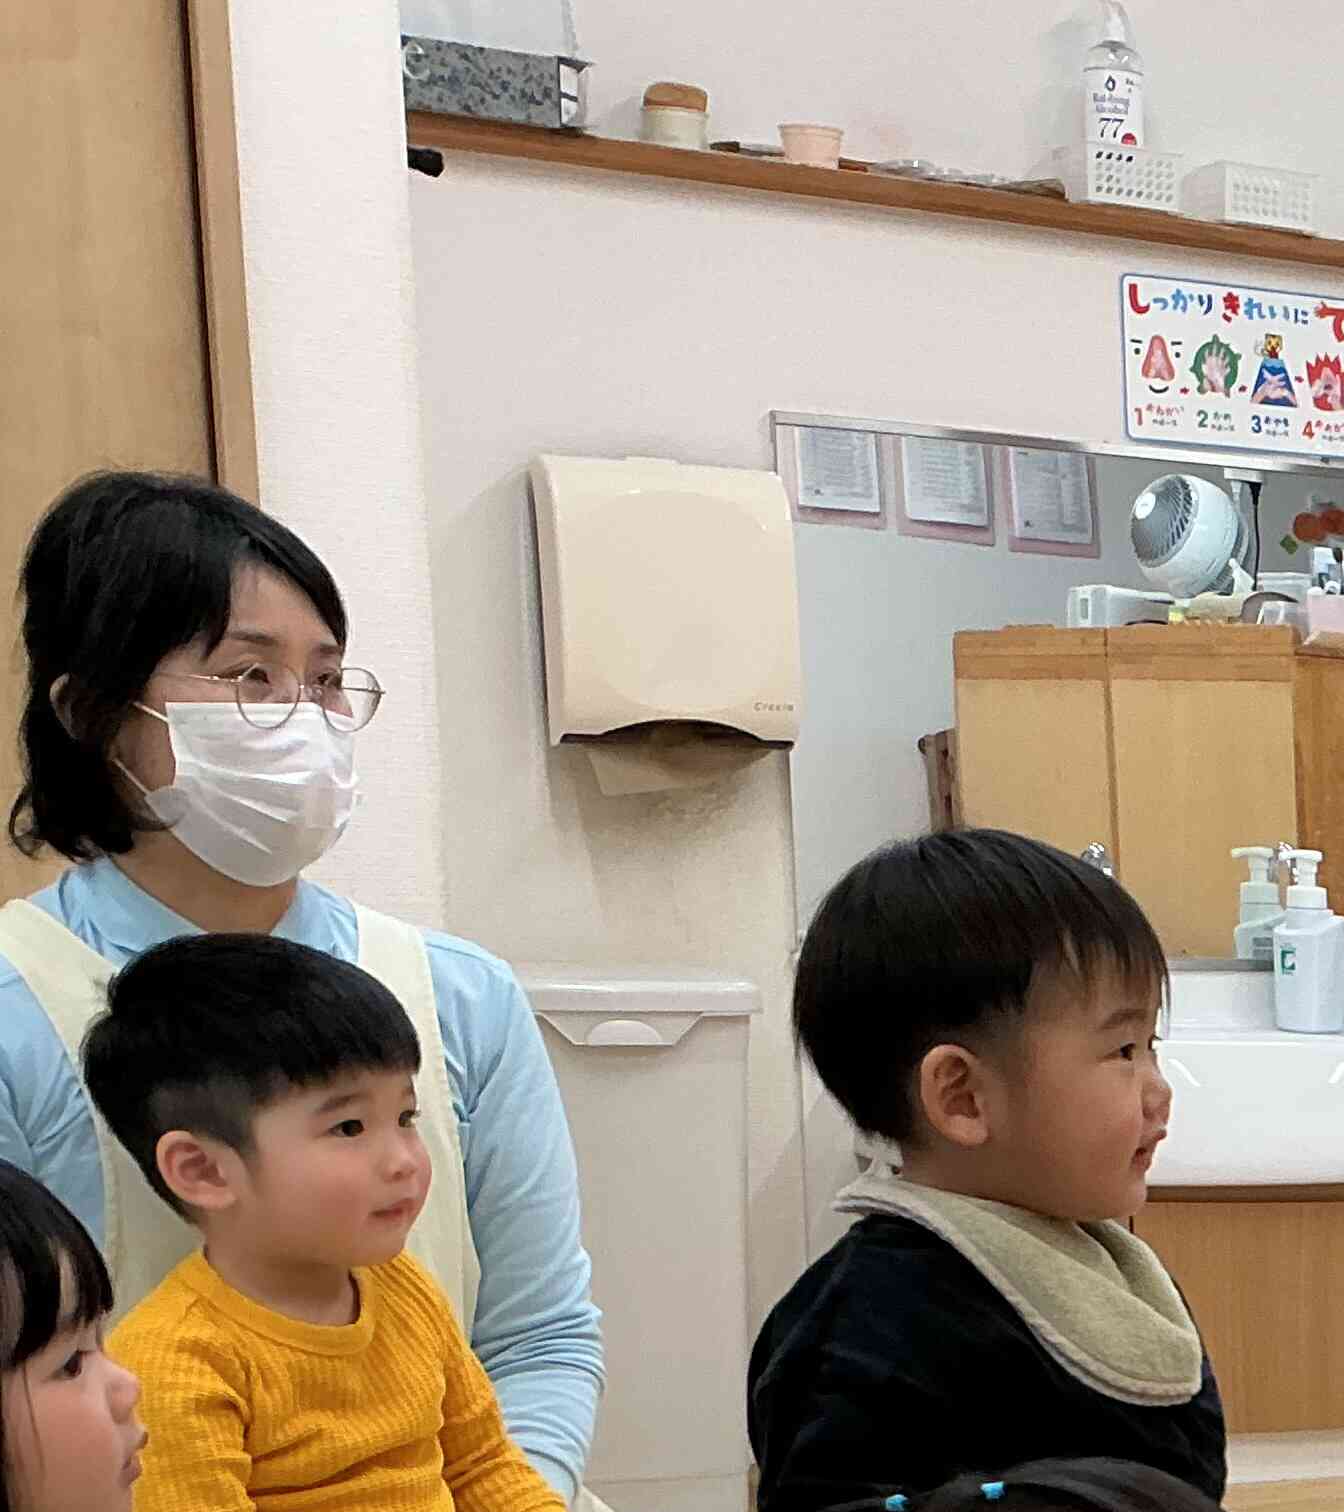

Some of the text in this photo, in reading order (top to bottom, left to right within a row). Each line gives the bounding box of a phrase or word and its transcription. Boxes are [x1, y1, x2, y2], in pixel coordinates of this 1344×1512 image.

[1098, 117, 1124, 138] 77
[1134, 407, 1144, 426] 1
[1196, 410, 1209, 428] 2
[1251, 415, 1262, 433] 3
[1302, 421, 1315, 439] 4
